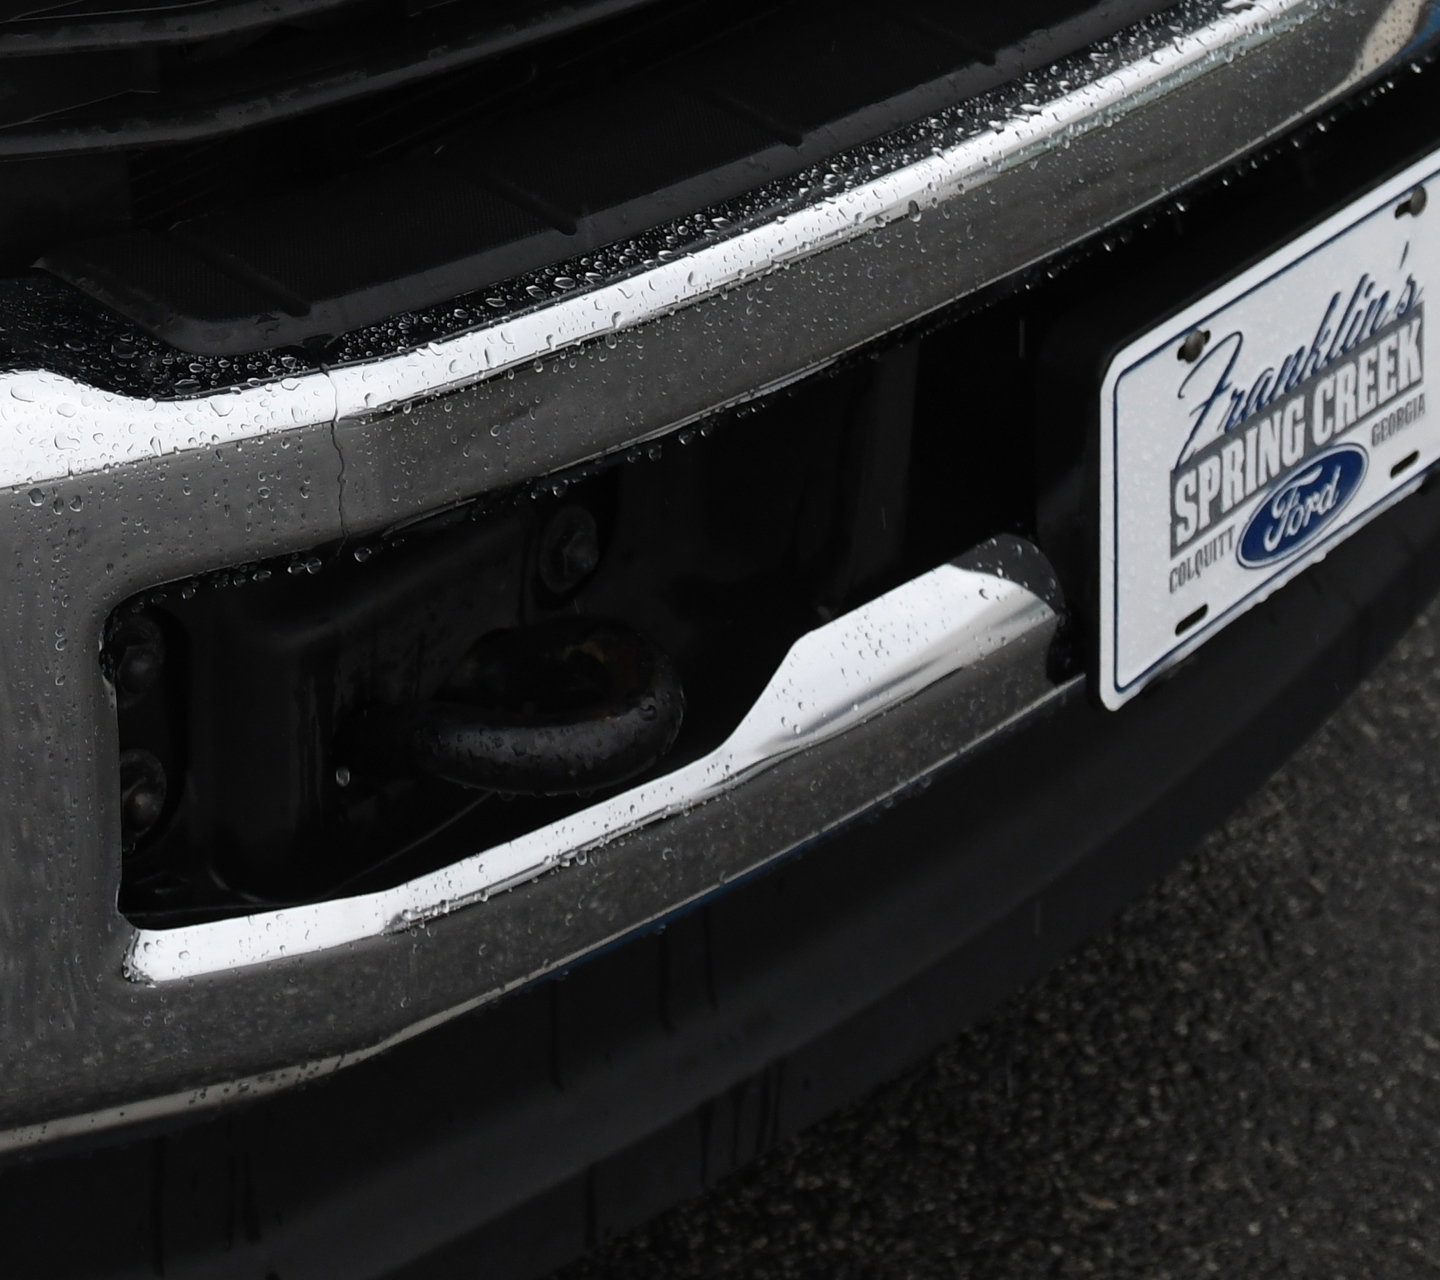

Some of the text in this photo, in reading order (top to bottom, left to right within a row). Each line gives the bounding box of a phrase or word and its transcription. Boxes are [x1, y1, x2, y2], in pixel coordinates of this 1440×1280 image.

[1176, 240, 1423, 470] Franklin's
[1174, 318, 1422, 546] SPRING CREEK
[1371, 392, 1426, 446] GEORGIA
[1263, 461, 1342, 552] Ford
[1169, 526, 1236, 594] COLQUITT
